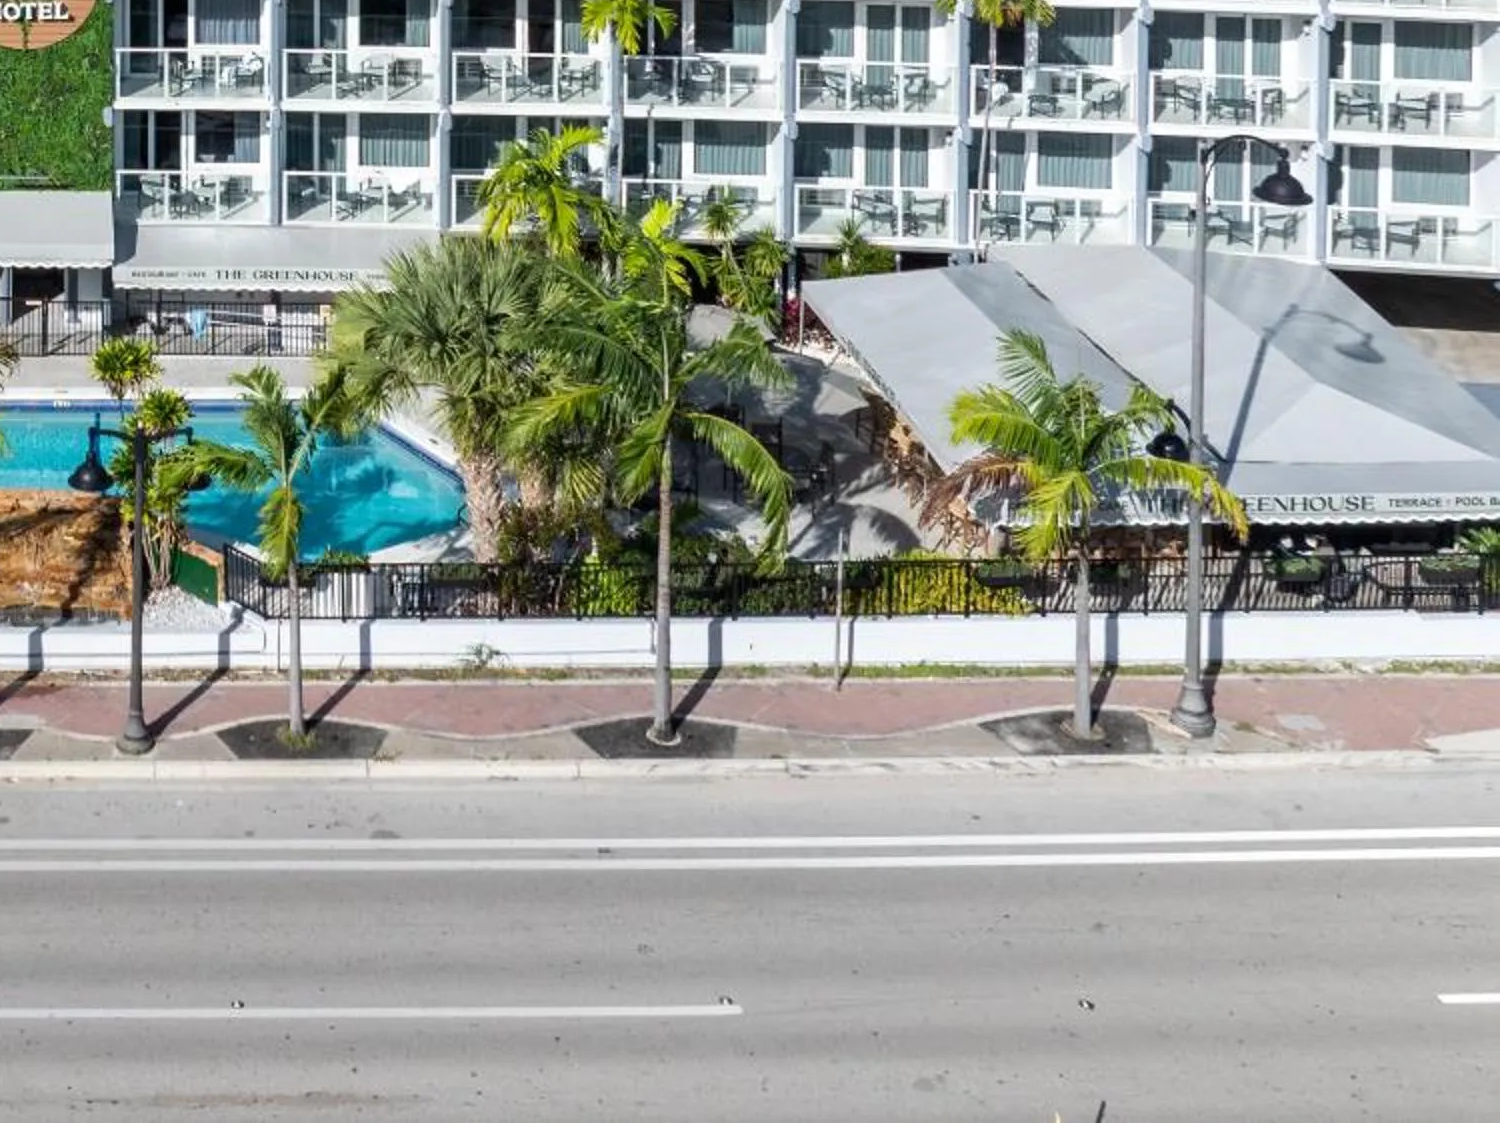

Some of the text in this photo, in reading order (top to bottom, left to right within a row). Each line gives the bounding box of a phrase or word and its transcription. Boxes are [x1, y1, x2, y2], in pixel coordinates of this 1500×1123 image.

[216, 270, 244, 280] THE
[252, 269, 357, 281] GREENHOUSE
[1238, 495, 1377, 512] EENHOUSE
[1388, 498, 1443, 508] TERRACE
[1455, 496, 1488, 507] POOL
